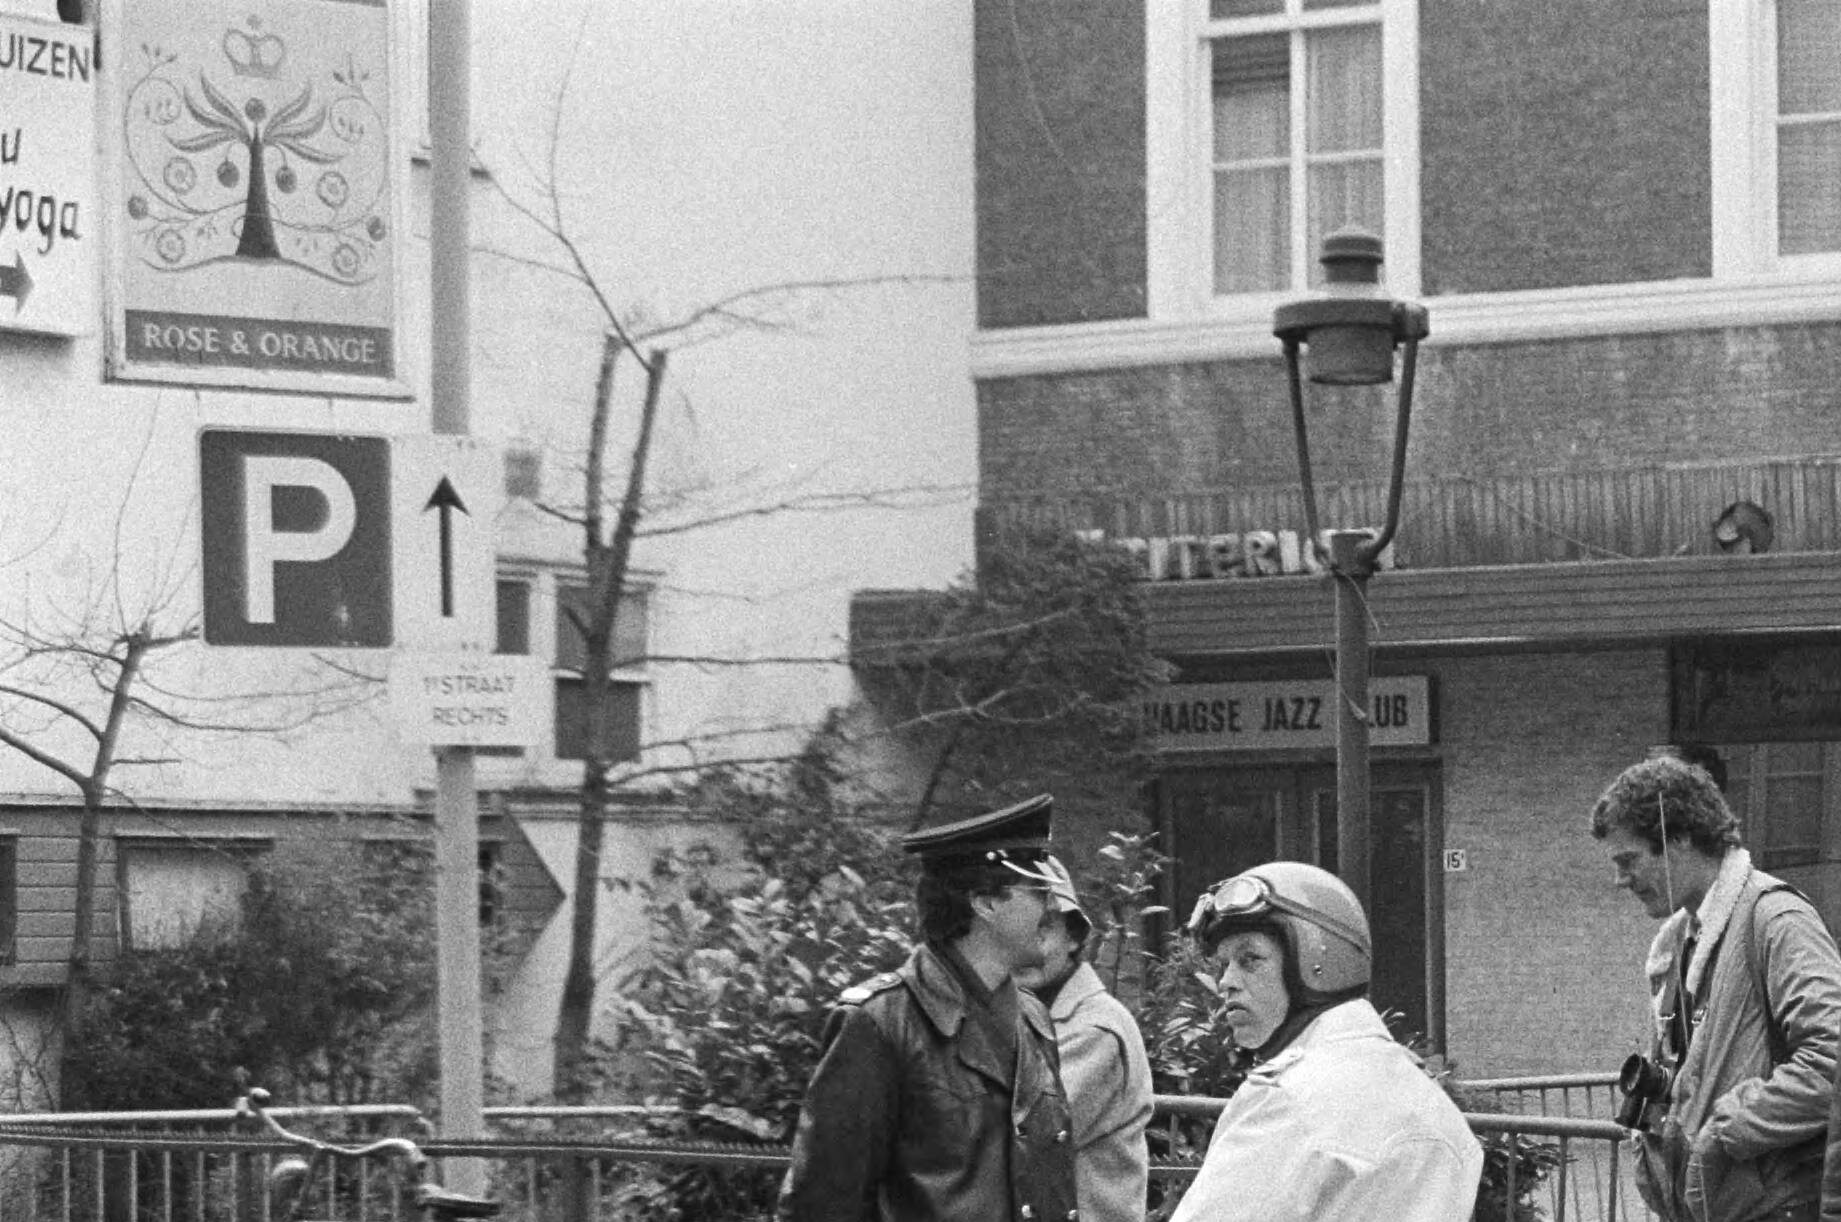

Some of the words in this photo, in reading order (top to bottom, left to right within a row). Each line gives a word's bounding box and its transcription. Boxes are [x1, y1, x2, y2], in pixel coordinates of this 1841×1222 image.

[143, 322, 220, 353] ROSE
[230, 330, 249, 355] &
[260, 332, 376, 363] ORANGE
[244, 456, 357, 624] P
[1262, 697, 1321, 731] JAZZ
